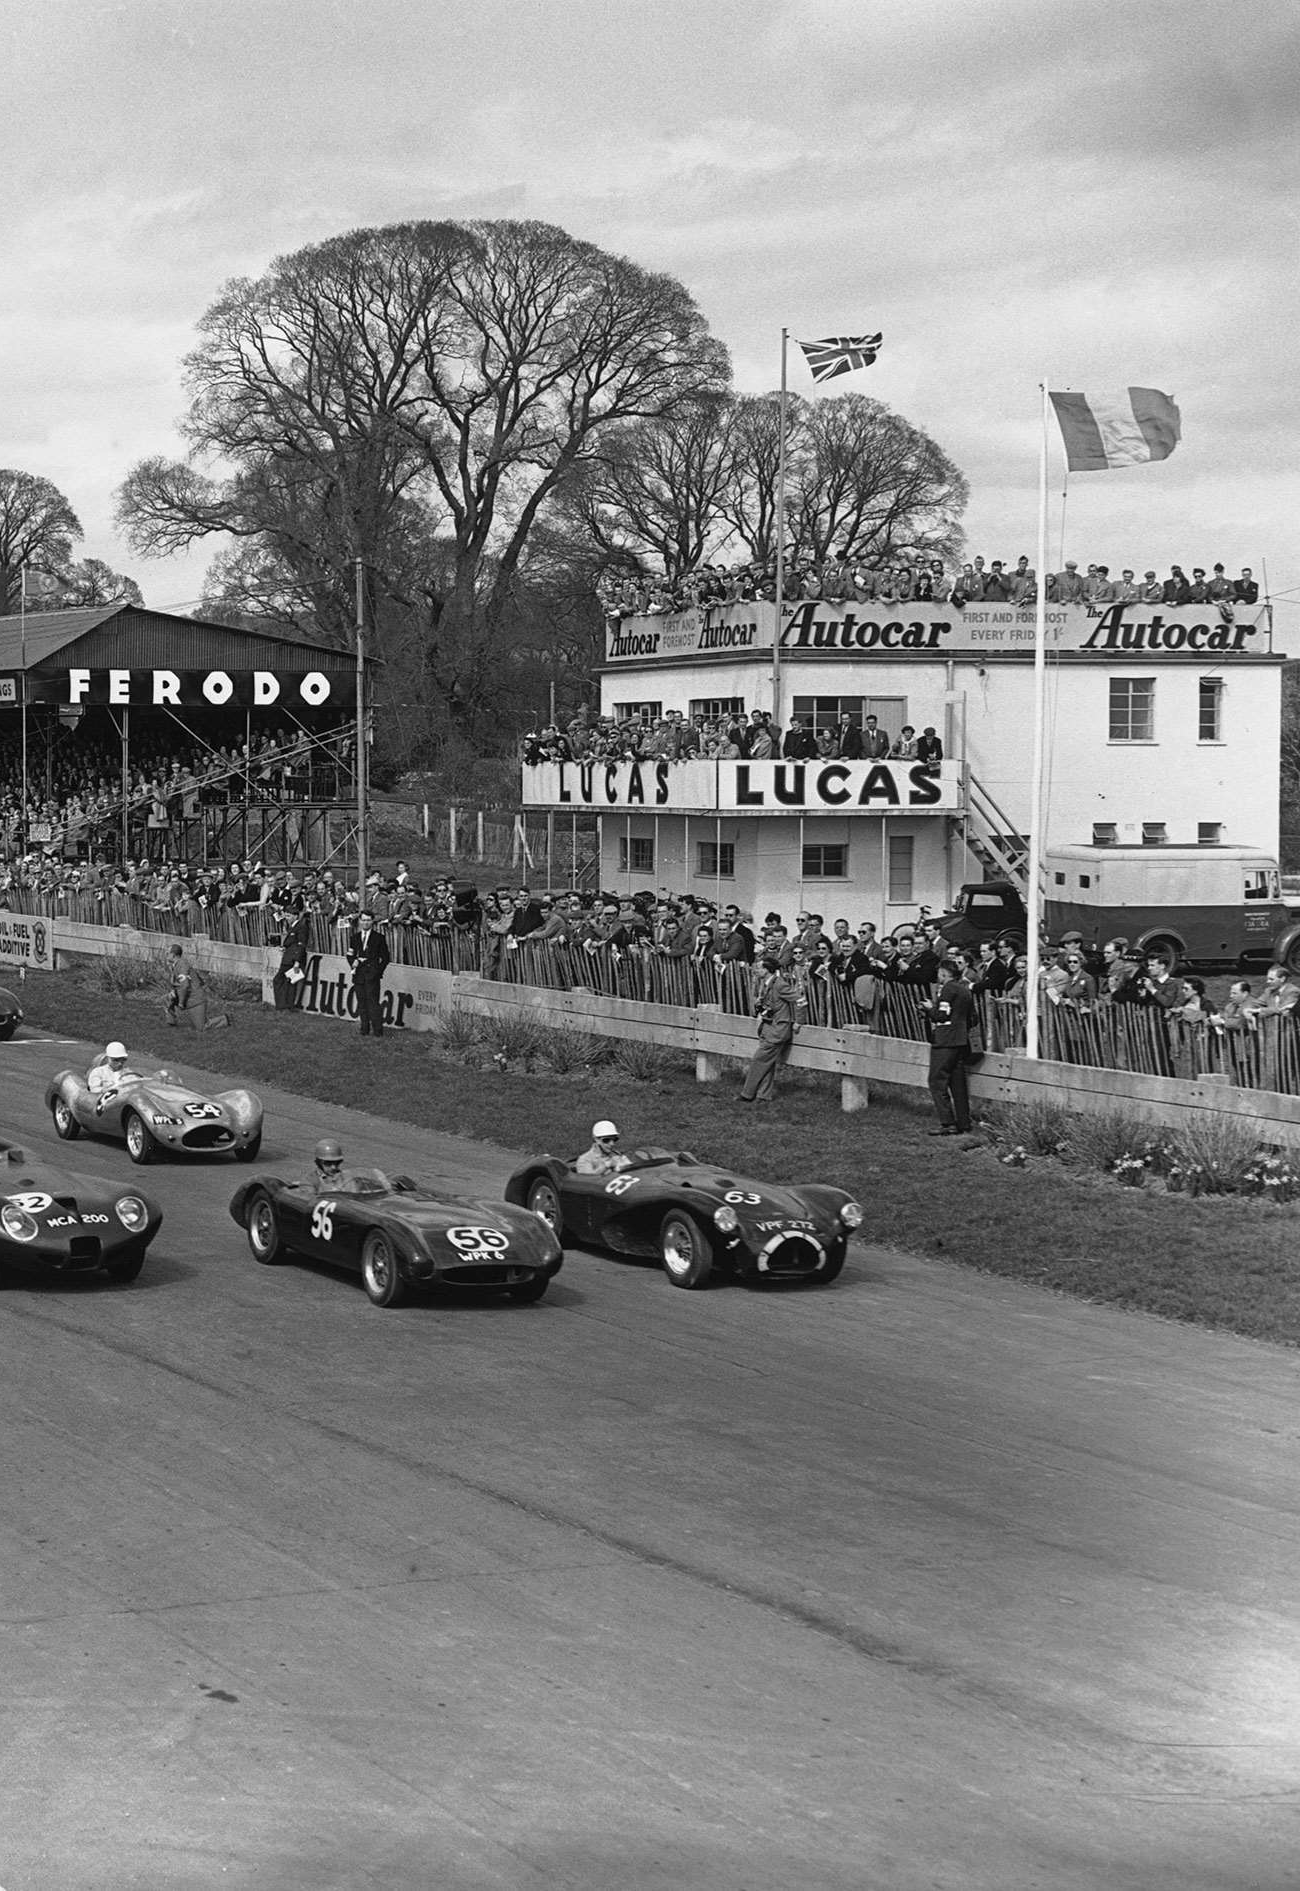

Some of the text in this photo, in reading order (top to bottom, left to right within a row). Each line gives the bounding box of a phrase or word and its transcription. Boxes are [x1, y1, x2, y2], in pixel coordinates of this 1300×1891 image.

[663, 618, 695, 632] FIRST AND
[770, 602, 952, 647] Autocar
[963, 613, 1068, 623] FIRST AND FOROST
[1079, 604, 1257, 649] The Autocar
[698, 607, 757, 648] Autocar
[971, 630, 1005, 640] EVERY
[1009, 630, 1048, 640] FRID
[609, 629, 661, 657] Autocar
[663, 634, 695, 649] FOREMOST
[69, 669, 331, 706] FERODO
[559, 763, 669, 804] LUCAS
[736, 764, 942, 805] LUCAS
[13, 923, 30, 939] FUEL
[294, 955, 414, 1028] Autoar
[418, 990, 437, 1002] EVERY
[185, 1102, 221, 1118] 54
[605, 1174, 640, 1195] 63
[724, 1191, 761, 1204] 63
[46, 1213, 109, 1228] MCA 200
[311, 1200, 337, 1240] 56
[756, 1220, 817, 1232] VPF 272
[454, 1230, 506, 1250] 56
[459, 1250, 505, 1262] WPK 6
